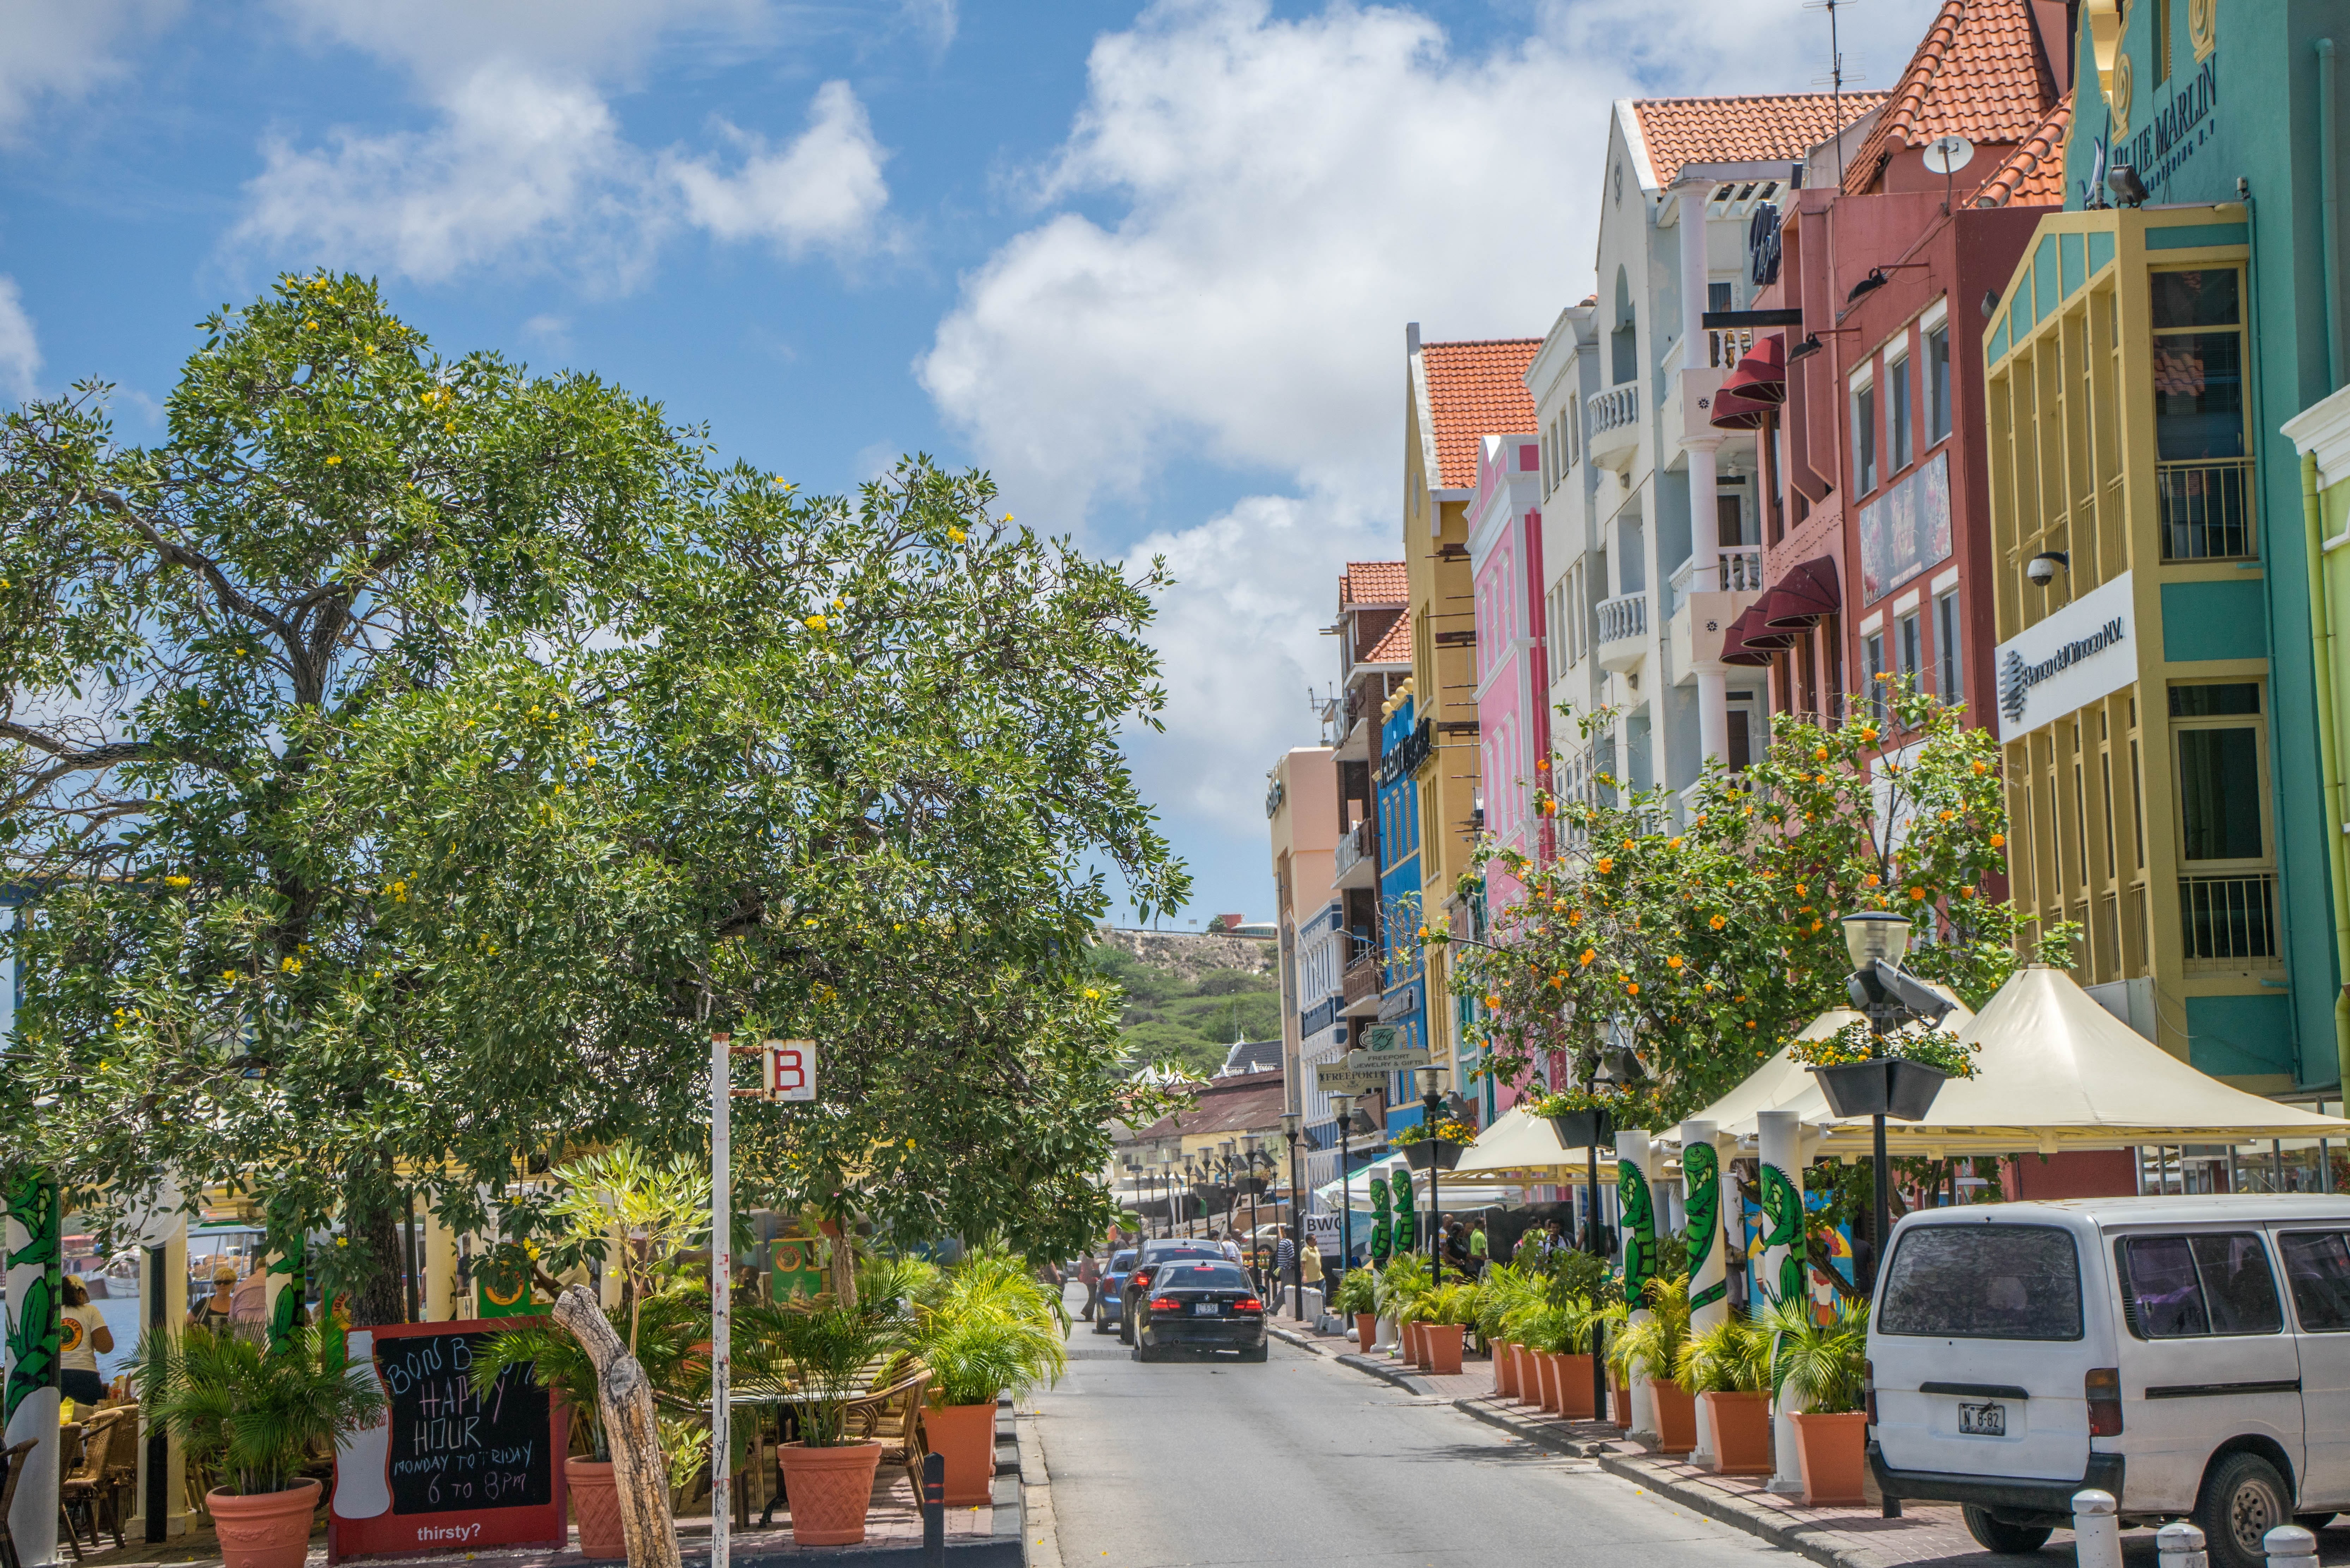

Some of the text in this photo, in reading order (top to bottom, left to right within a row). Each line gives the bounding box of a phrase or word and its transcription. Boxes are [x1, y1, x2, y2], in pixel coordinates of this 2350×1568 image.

[2155, 53, 2216, 161] MARLIN
[2024, 617, 2123, 688] Banco del Orinoco N.V.
[775, 1050, 805, 1091] B
[1326, 1071, 1377, 1081] FREEPORT
[387, 1338, 441, 1394] BON
[413, 1416, 481, 1455] HOUR
[1964, 1411, 1998, 1427] N 8-82
[394, 1454, 449, 1476] MONDAY
[456, 1454, 475, 1471] TO
[429, 1473, 441, 1503] 6
[451, 1482, 472, 1498] TO
[417, 1523, 481, 1541] thirsty?
